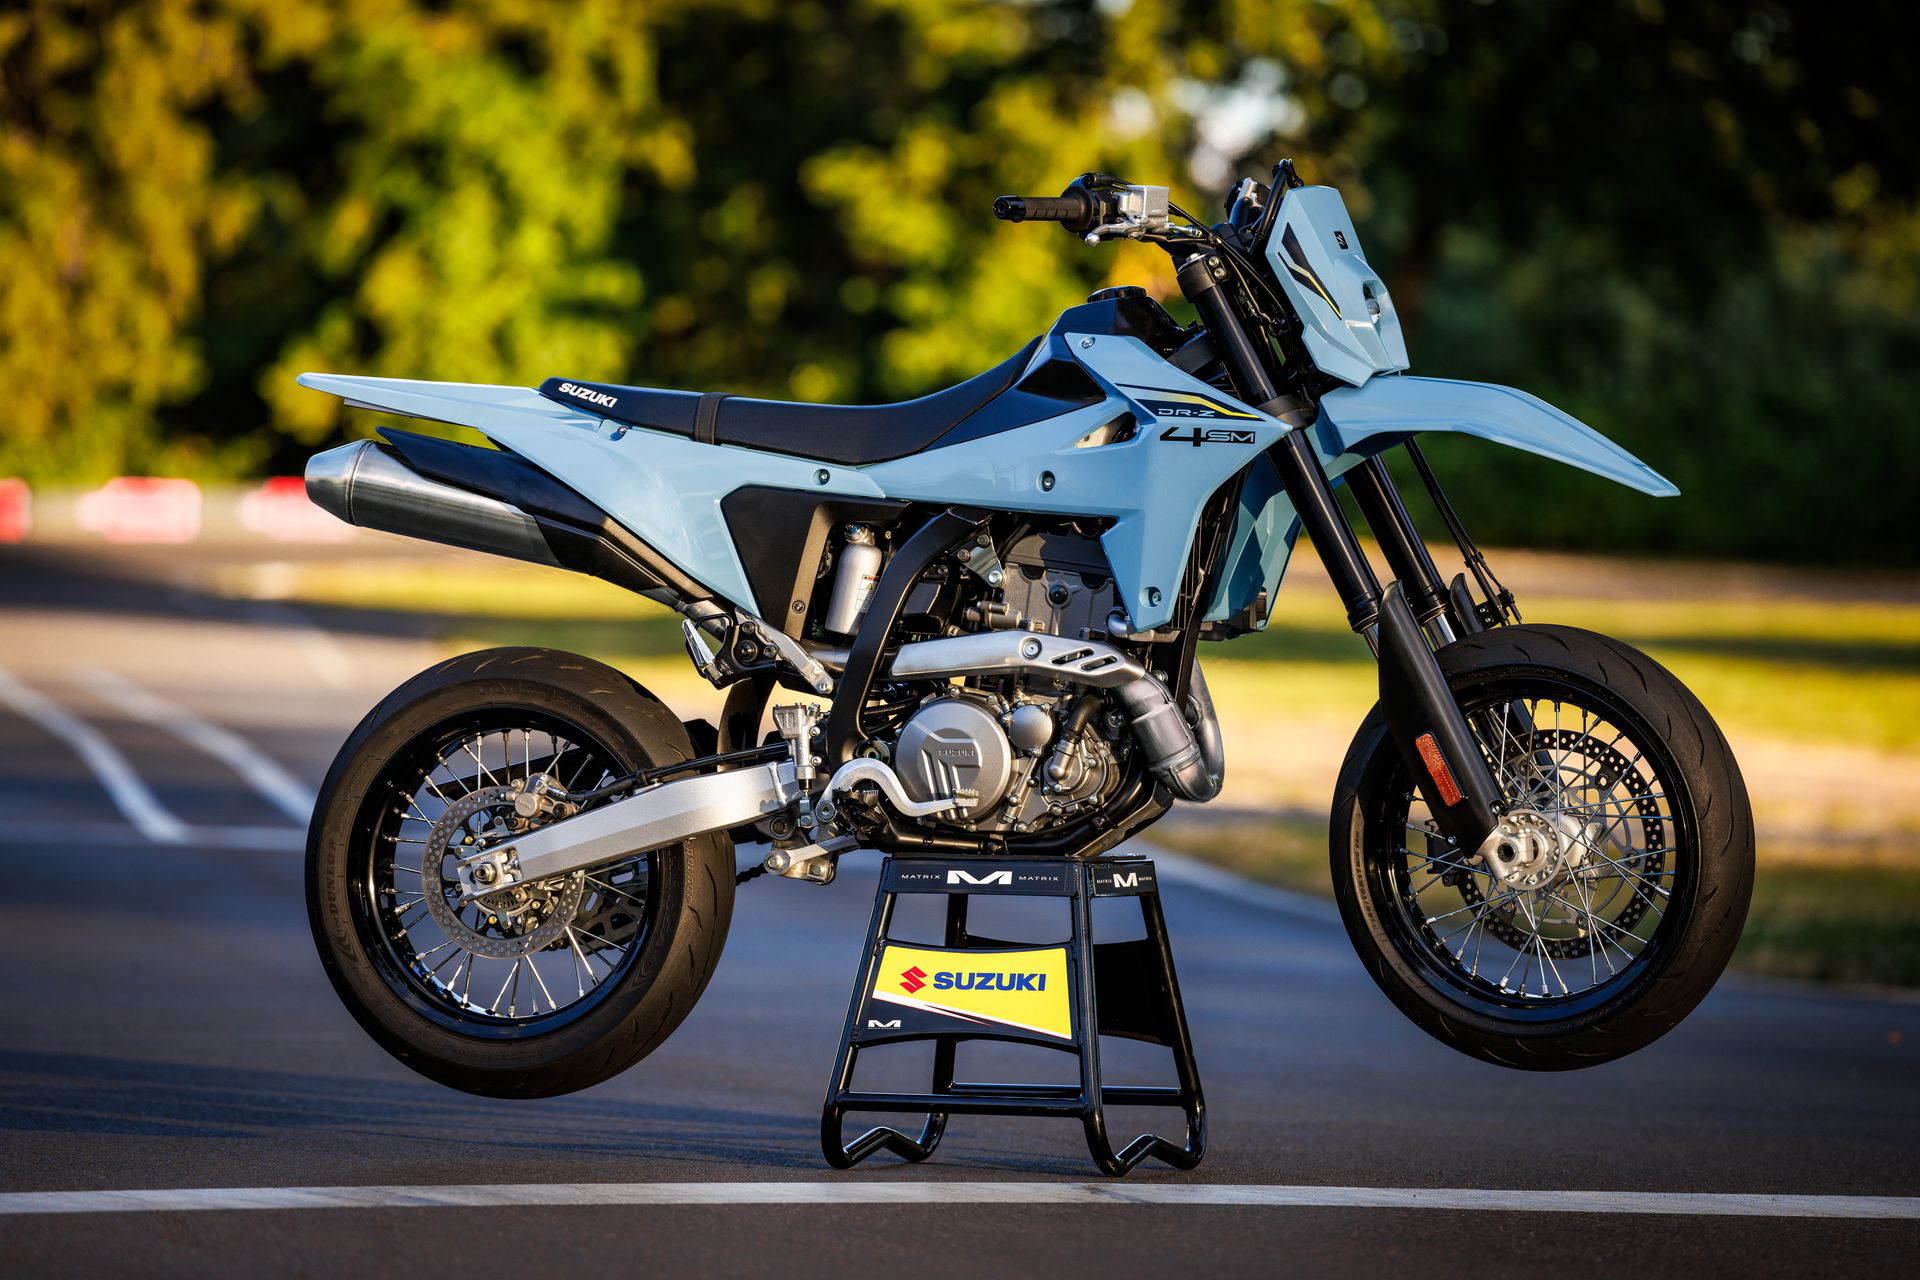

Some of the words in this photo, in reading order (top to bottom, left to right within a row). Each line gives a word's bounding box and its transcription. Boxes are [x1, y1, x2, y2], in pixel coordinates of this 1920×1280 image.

[558, 382, 618, 408] SUZUKI
[1158, 408, 1215, 418] DR-Z
[938, 749, 975, 757] SUZUKI
[933, 971, 1047, 992] SUZUKI
